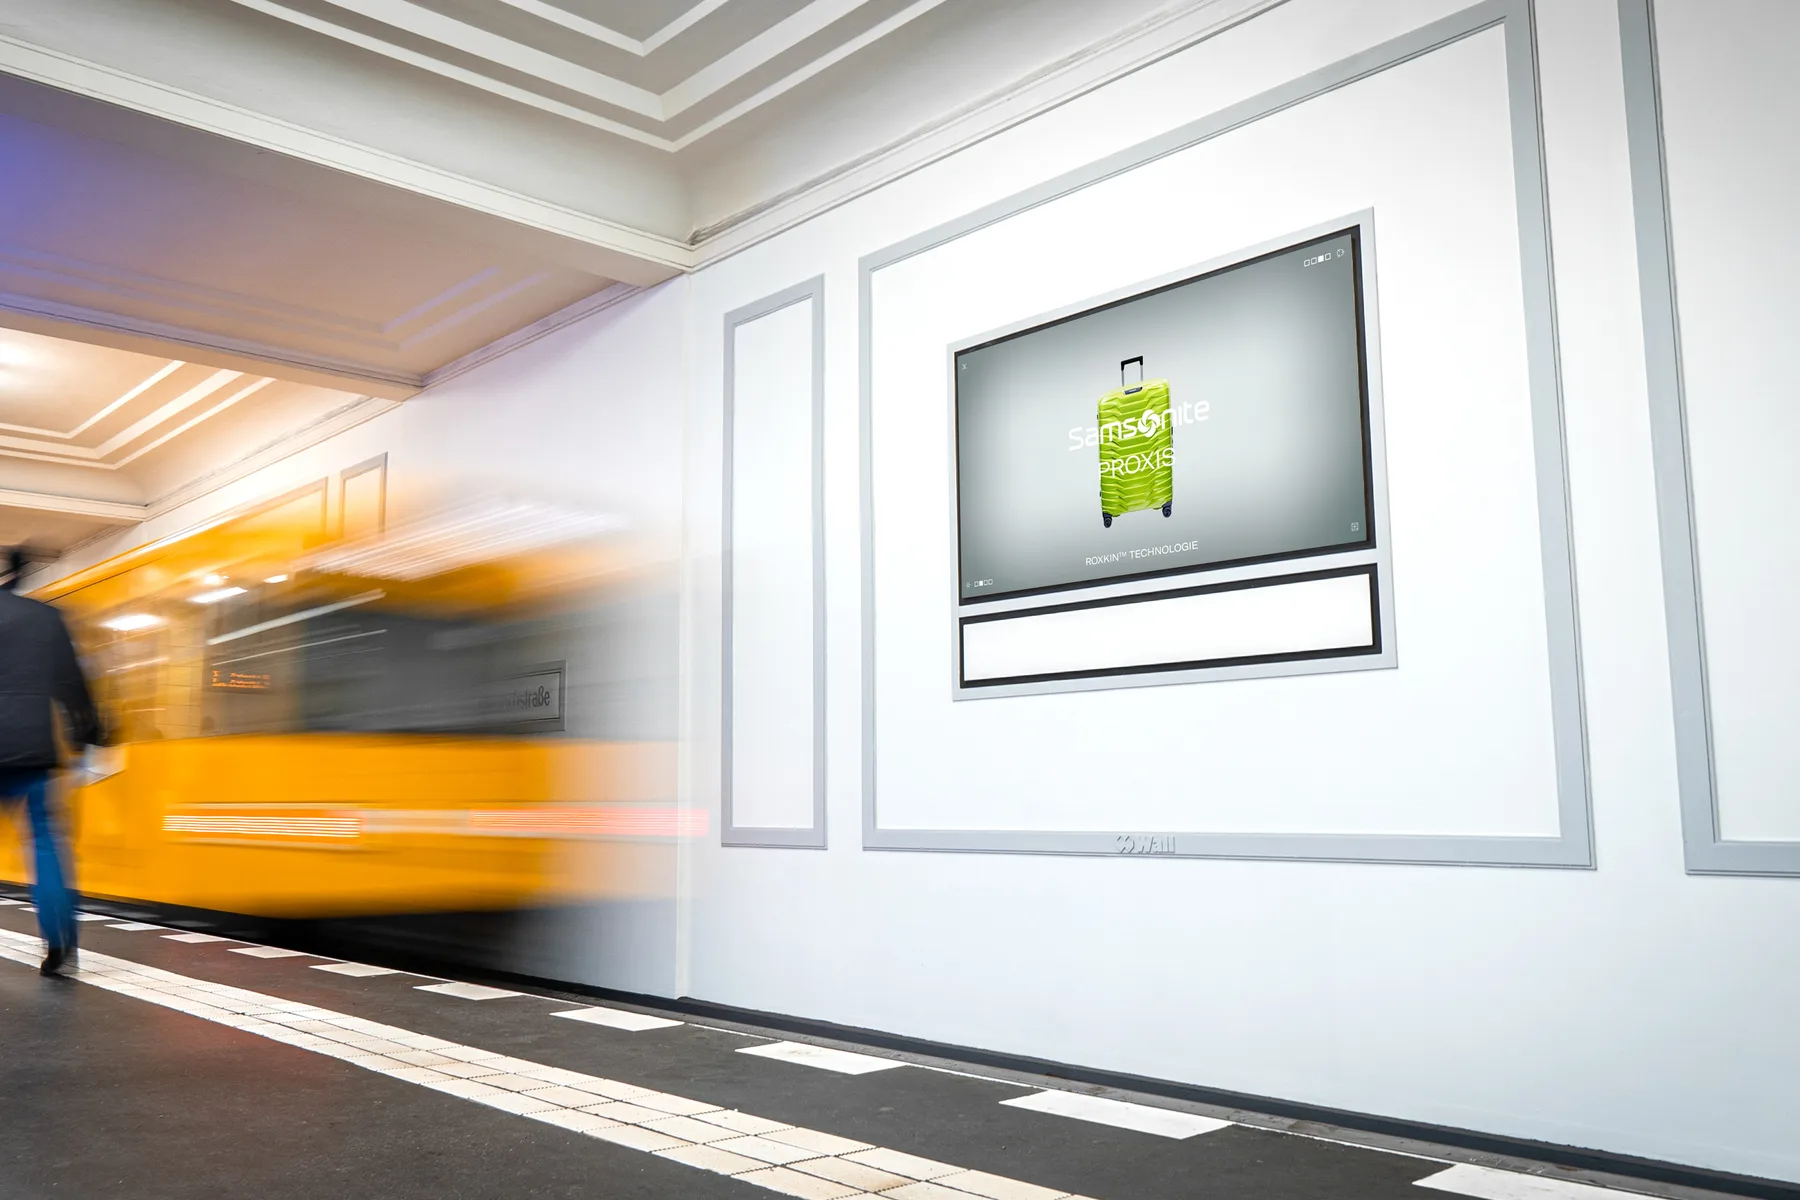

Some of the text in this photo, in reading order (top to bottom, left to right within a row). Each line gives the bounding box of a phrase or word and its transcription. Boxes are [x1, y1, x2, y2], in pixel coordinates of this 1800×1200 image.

[1068, 400, 1210, 451] Samsonite
[1098, 447, 1176, 482] PROXIS
[1129, 540, 1199, 560] TECHNOLOGIE
